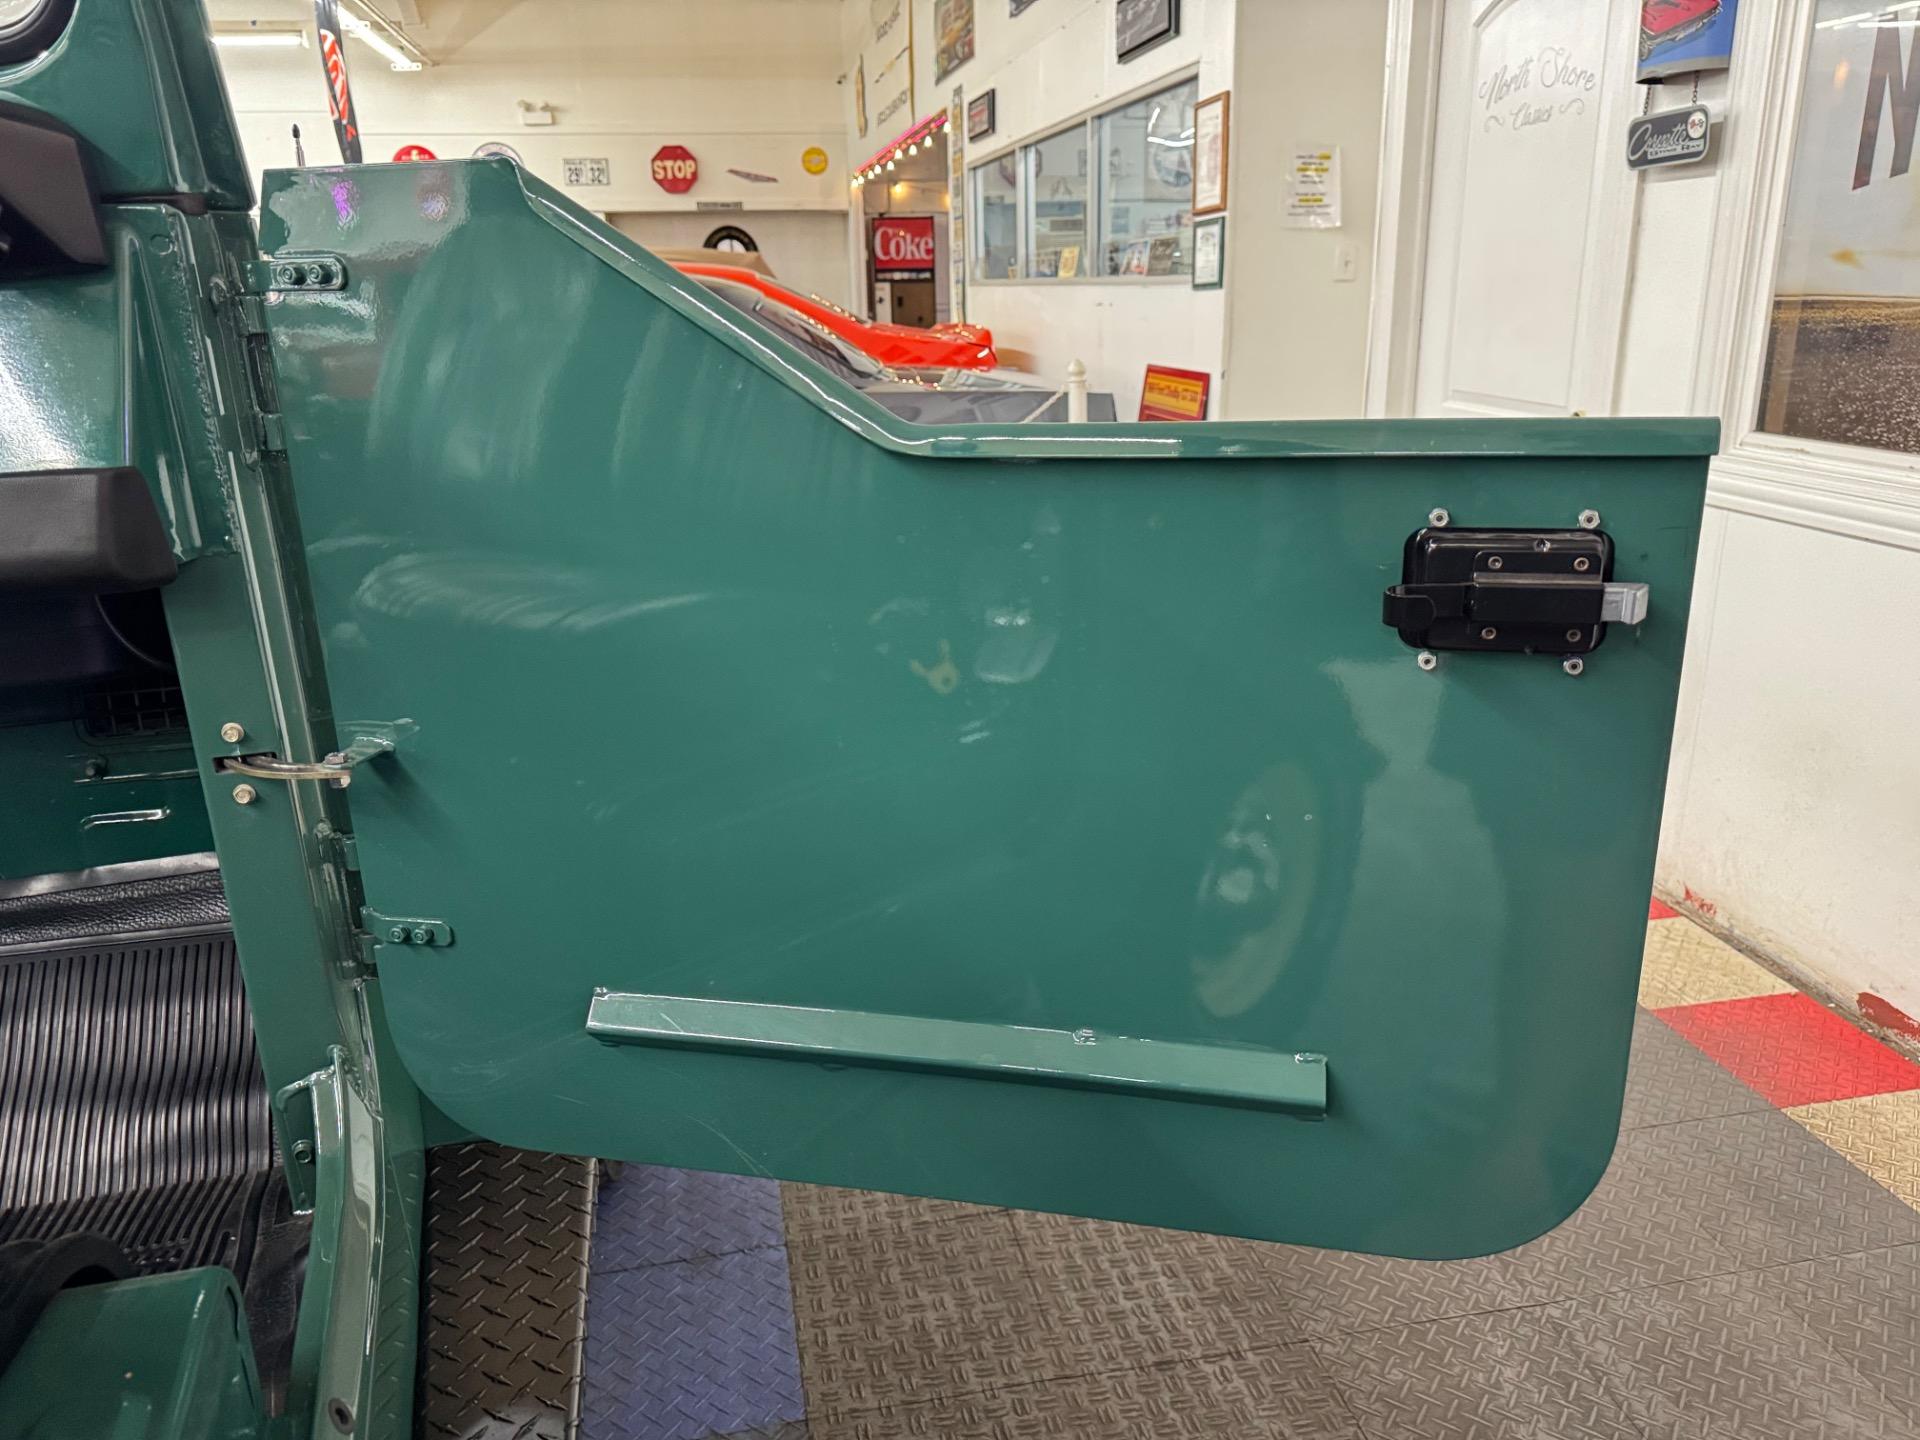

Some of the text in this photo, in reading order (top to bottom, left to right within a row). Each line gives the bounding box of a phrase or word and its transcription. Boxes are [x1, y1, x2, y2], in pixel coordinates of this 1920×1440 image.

[1479, 46, 1596, 111] North Shore
[1628, 122, 1689, 160] Corvette
[652, 160, 696, 180] STOP
[874, 226, 934, 260] Coke
